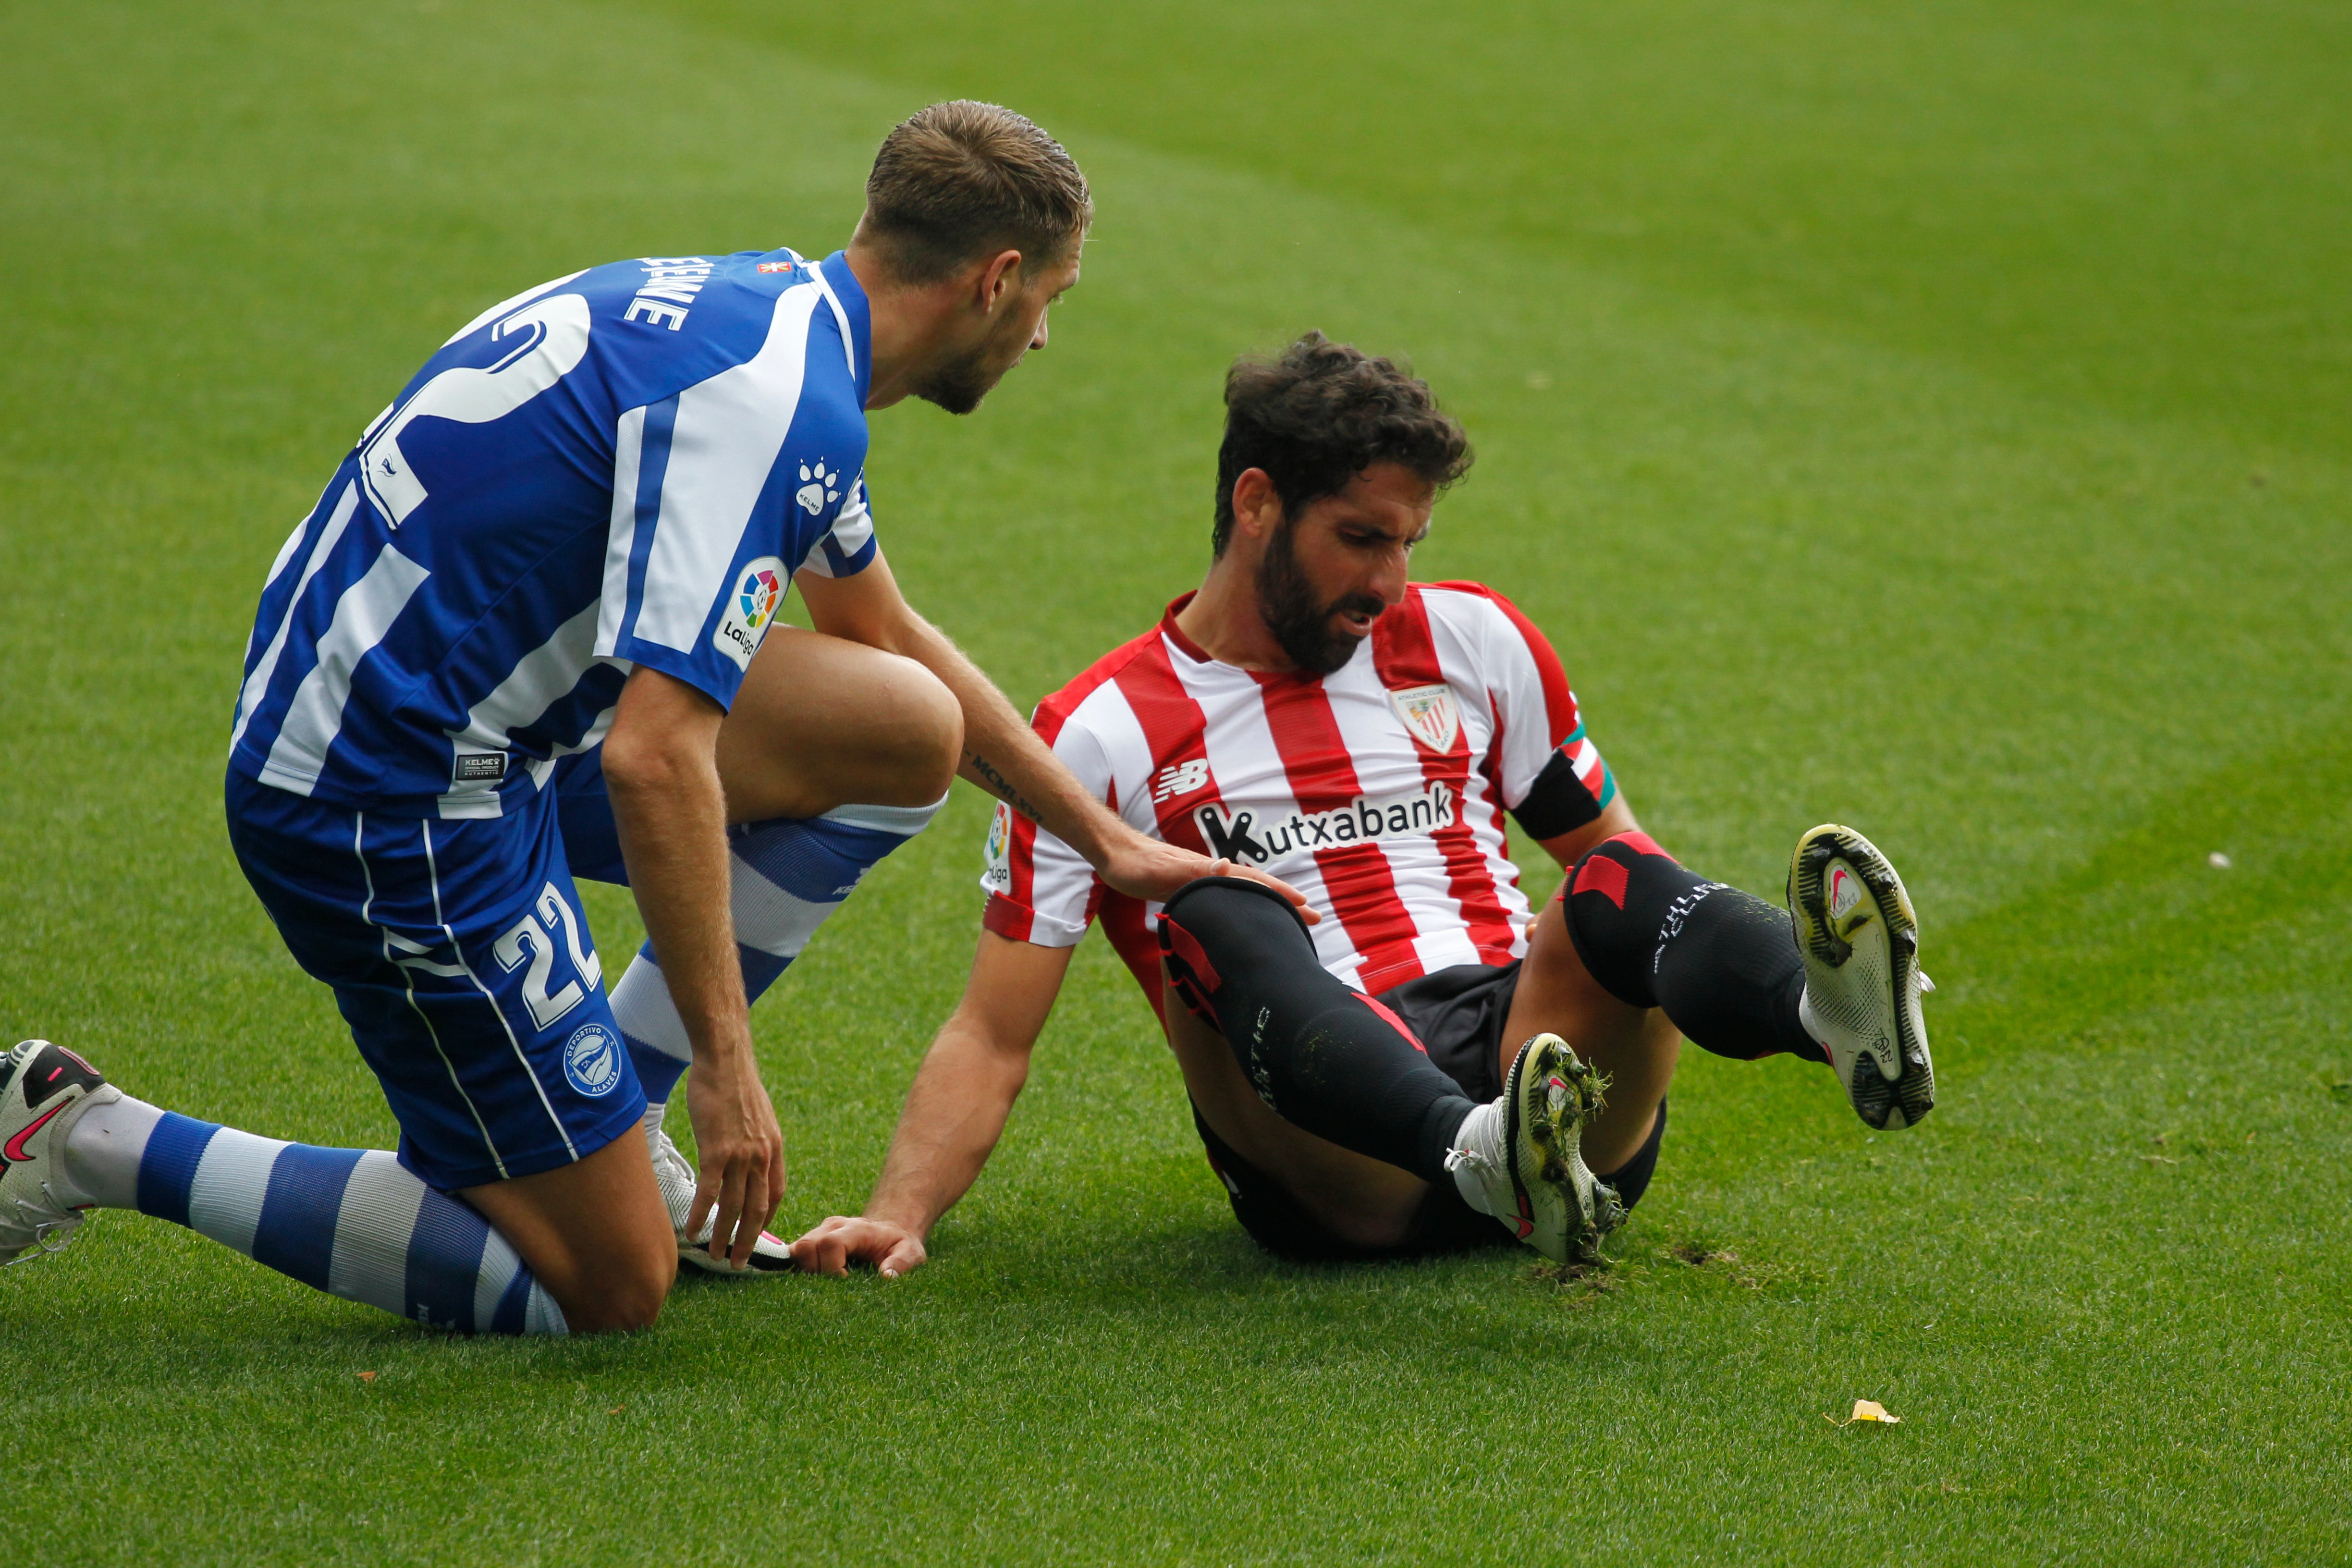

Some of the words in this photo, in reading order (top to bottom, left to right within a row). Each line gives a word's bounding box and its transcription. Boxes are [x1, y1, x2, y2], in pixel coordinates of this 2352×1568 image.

[355, 268, 591, 531] 2
[799, 493, 821, 512] KELME
[723, 621, 754, 656] LaLiga
[1398, 692, 1427, 701] ATHLETIC
[1200, 786, 1449, 864] Kutxabank
[989, 864, 1007, 883] Liga
[492, 881, 602, 1033] 22
[567, 1027, 601, 1057] DEPORTIVO
